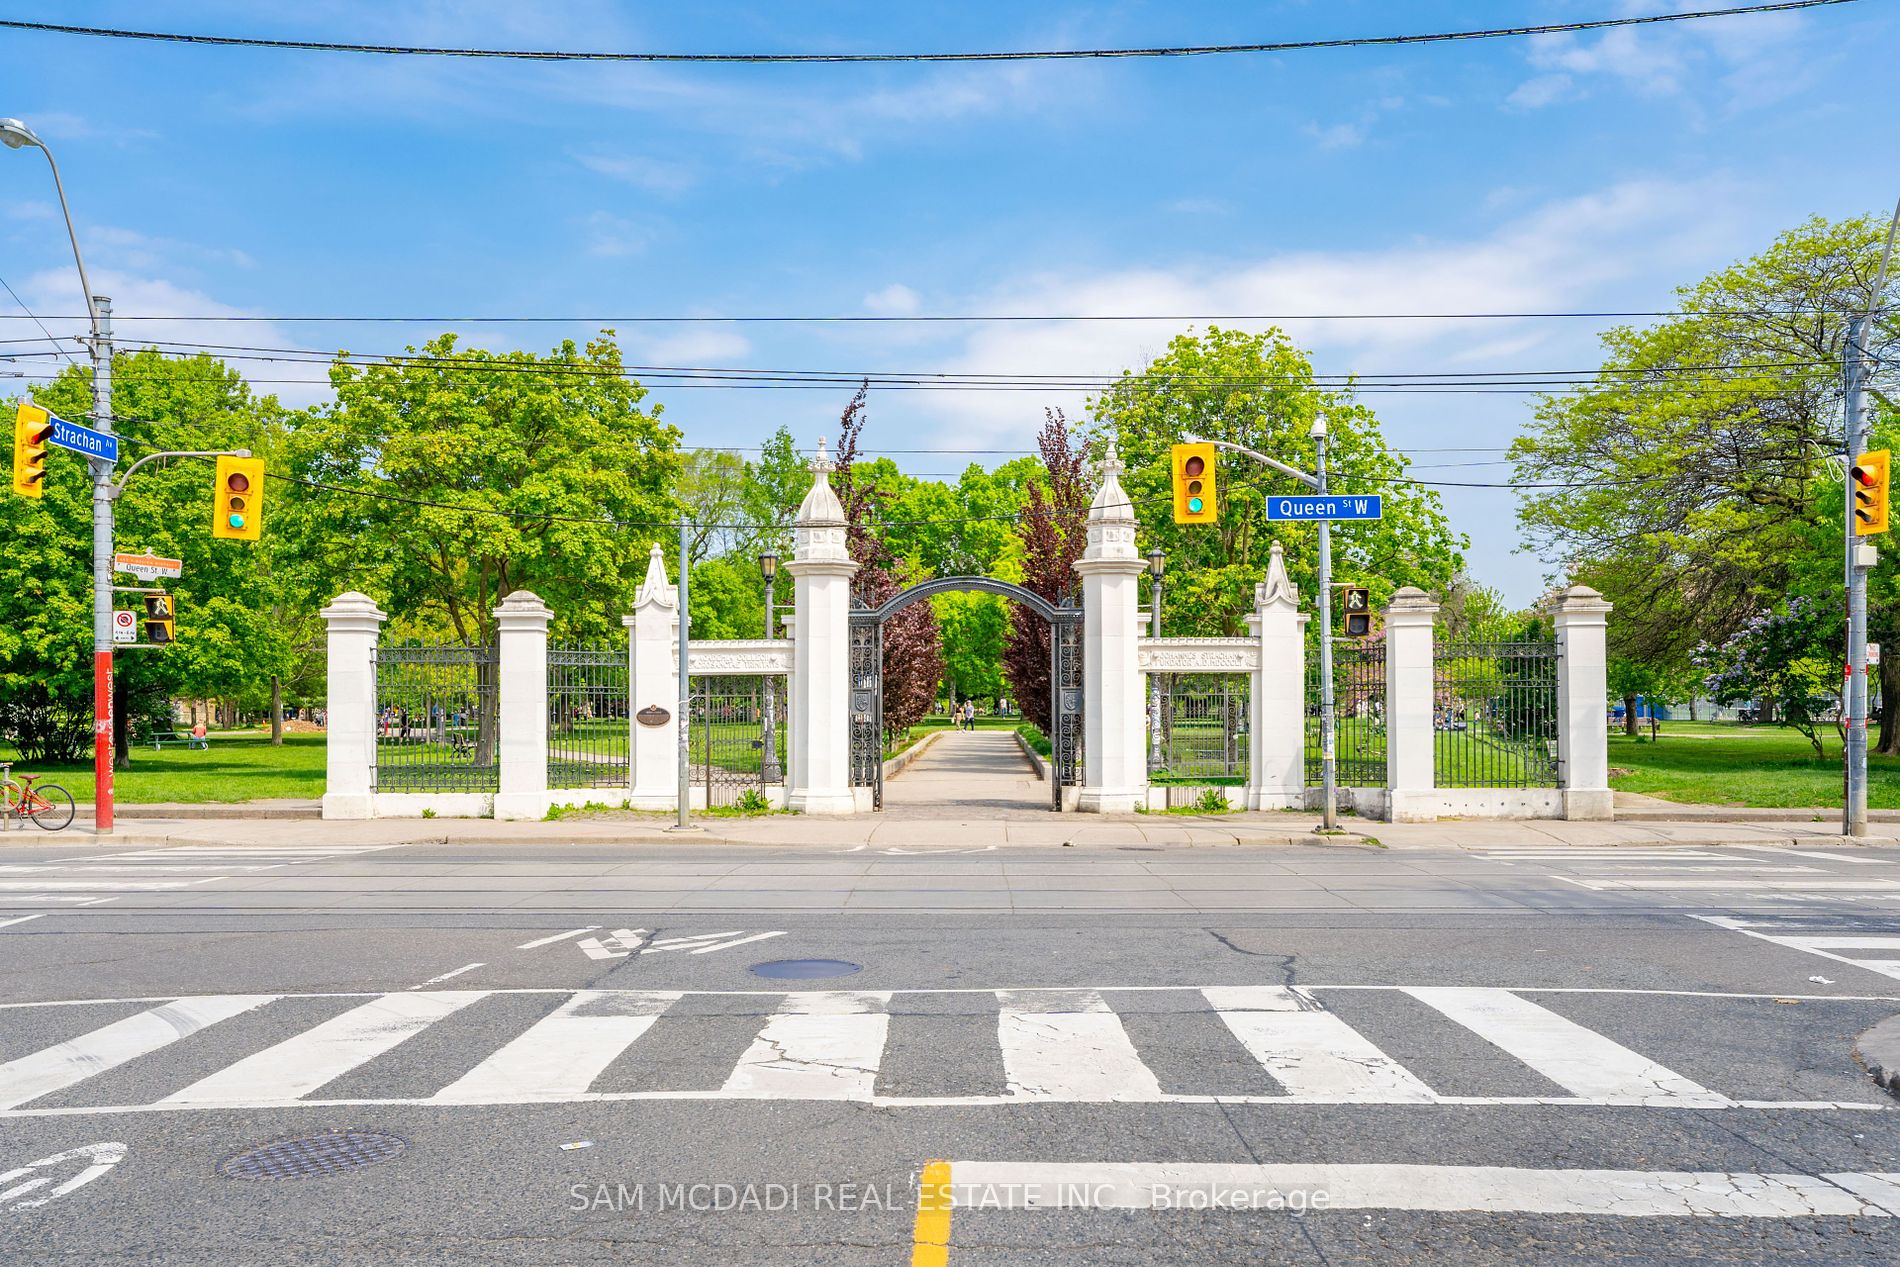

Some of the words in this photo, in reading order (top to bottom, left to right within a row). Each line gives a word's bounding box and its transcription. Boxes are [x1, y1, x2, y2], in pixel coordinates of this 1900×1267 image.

[54, 422, 102, 452] Strachan
[1280, 500, 1336, 517] Queen
[1342, 499, 1352, 508] St
[1355, 499, 1368, 515] W
[126, 564, 149, 573] Queen
